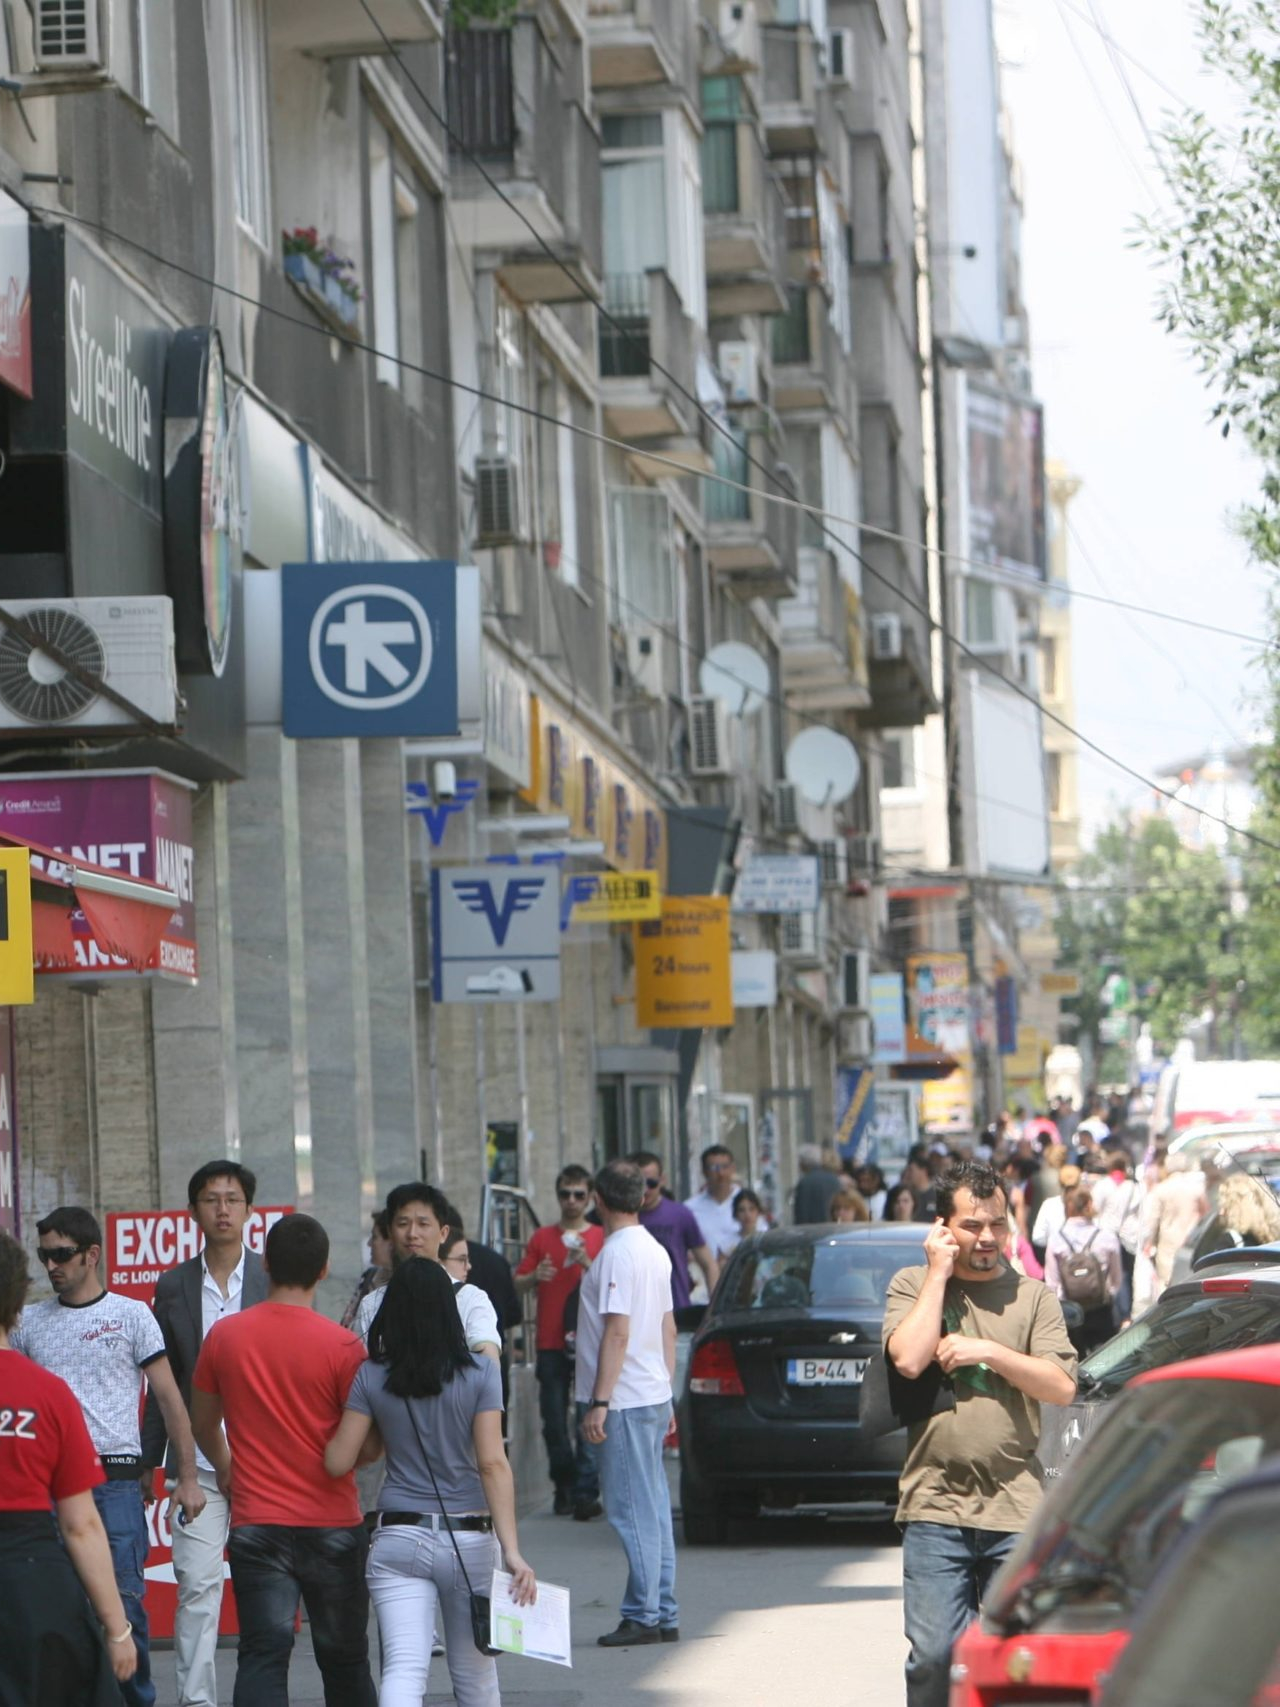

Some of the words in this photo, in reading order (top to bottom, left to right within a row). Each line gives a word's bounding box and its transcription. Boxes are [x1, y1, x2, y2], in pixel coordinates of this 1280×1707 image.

[70, 276, 151, 471] Streetline
[653, 955, 675, 976] 24
[112, 1272, 128, 1285] SC
[804, 1362, 817, 1380] B
[825, 1361, 847, 1379] 44
